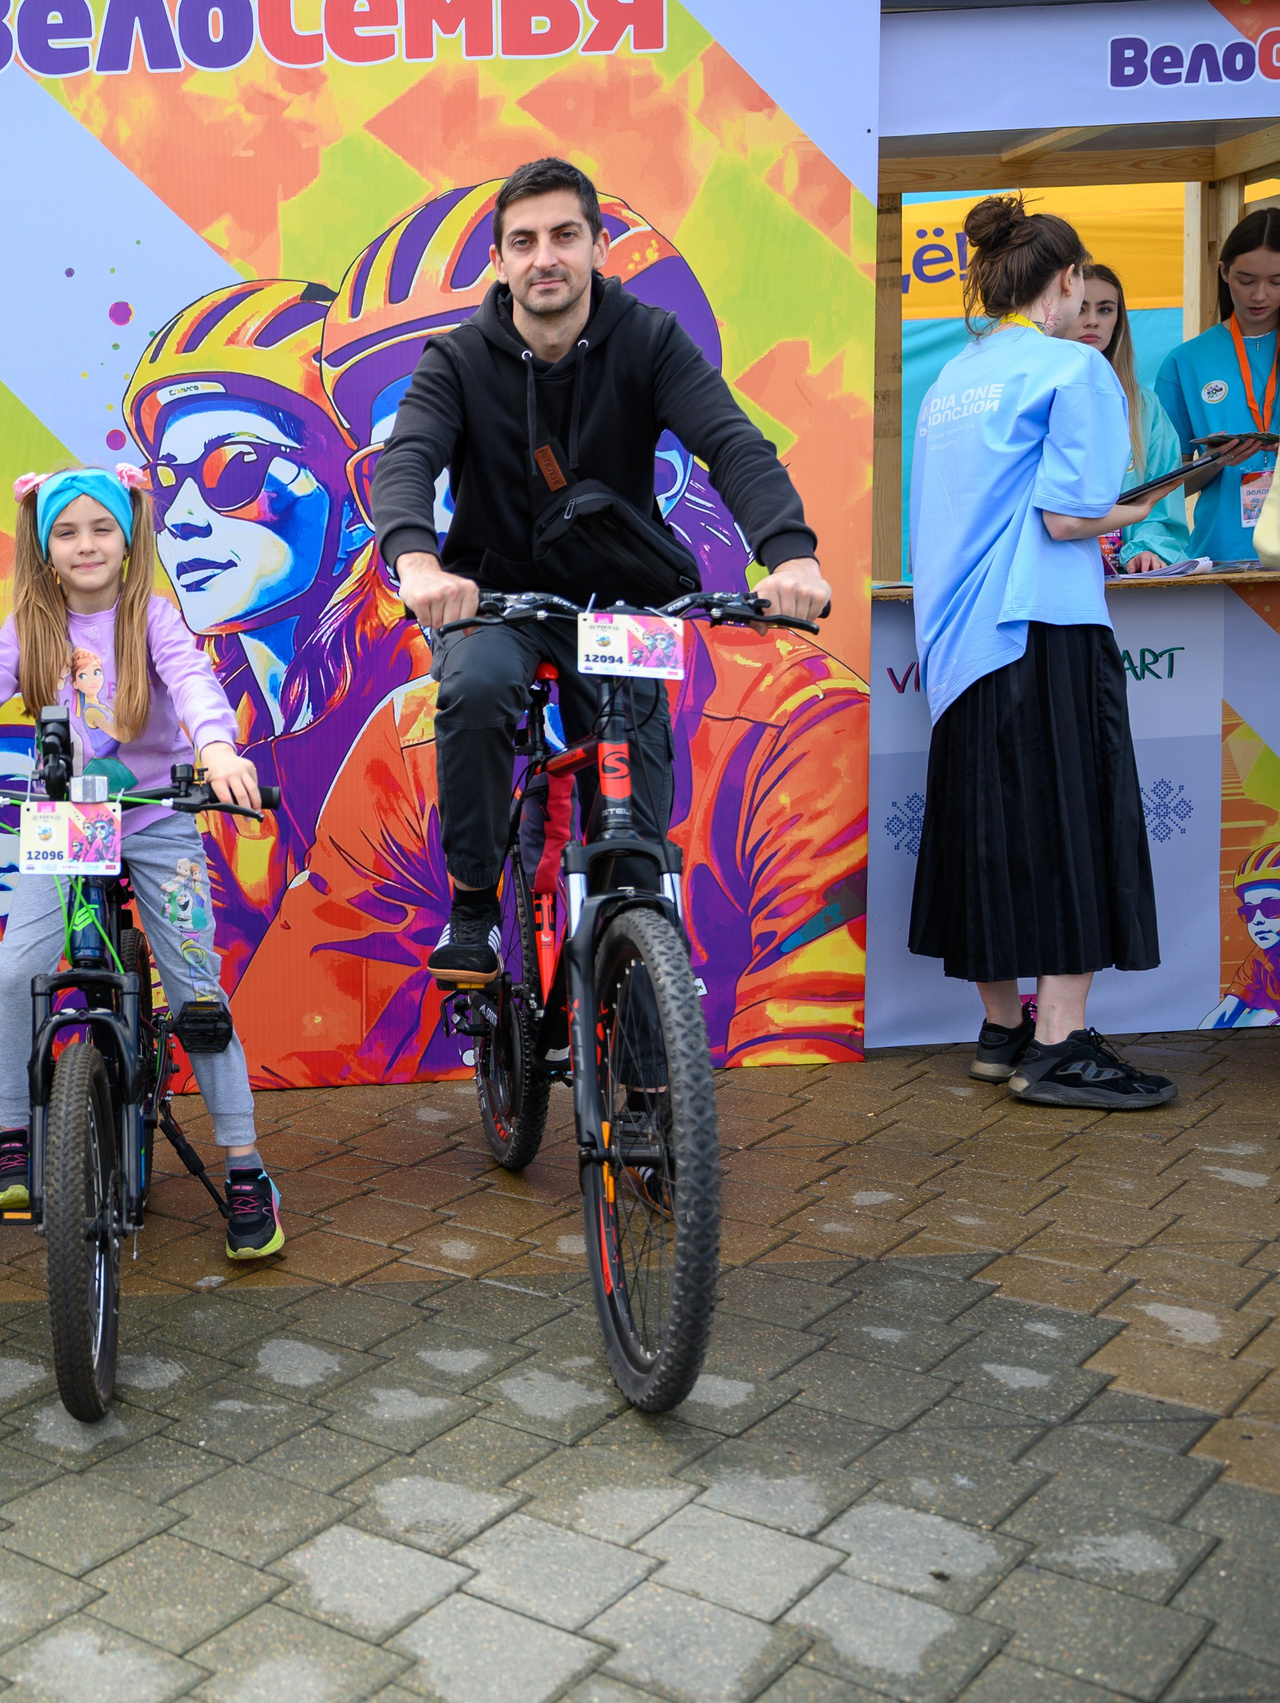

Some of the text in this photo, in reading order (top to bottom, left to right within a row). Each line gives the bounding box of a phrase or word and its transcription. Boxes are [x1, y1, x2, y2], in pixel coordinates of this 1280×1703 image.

[902, 227, 968, 294] ё!
[961, 383, 1005, 404] ONE
[584, 654, 624, 664] 12094
[602, 807, 632, 817] STEL
[26, 850, 64, 861] 12096
